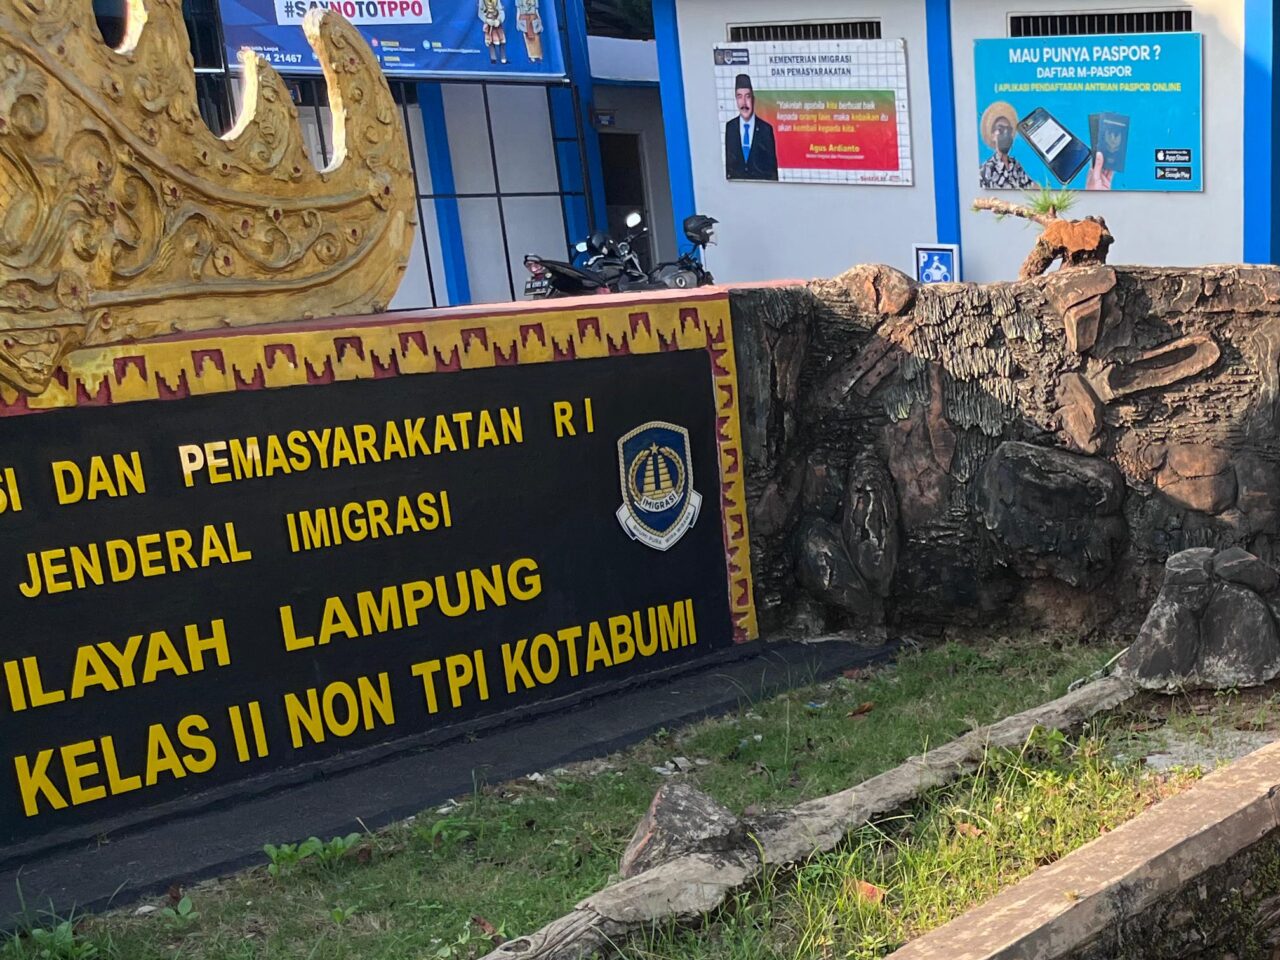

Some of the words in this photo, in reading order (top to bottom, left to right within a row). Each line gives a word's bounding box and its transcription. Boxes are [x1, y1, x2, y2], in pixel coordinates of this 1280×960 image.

[273, 53, 302, 63] 21467
[769, 55, 817, 64] KEMENTERIAN
[818, 55, 852, 64] IMIGRASI
[1009, 48, 1040, 63] MAU
[1043, 46, 1090, 63] PUNYA
[1092, 45, 1151, 62] PASPOR
[771, 68, 786, 76] DAN
[787, 67, 852, 76] PEMASYARAKATAN
[1036, 66, 1075, 78] DAFTAR
[1077, 66, 1132, 78] M-PASPOR
[1085, 82, 1118, 91] ANTRIAN
[1119, 82, 1151, 92] PASPOR
[1152, 82, 1182, 92] ONLINE
[809, 144, 827, 153] Agus
[828, 144, 860, 153] Ardianto
[919, 253, 929, 267] P
[51, 450, 147, 506] DAN
[178, 406, 524, 488] PEMASYARAKATAN
[642, 493, 677, 510] IMIGRASI
[18, 521, 252, 598] JENDERAL
[286, 490, 452, 553] IMIGRASI
[3, 618, 231, 712] ILAYAH
[279, 557, 543, 652] LAMPUNG
[14, 714, 217, 818] KELAS
[228, 700, 269, 763] II
[283, 671, 396, 750] NON
[411, 649, 490, 715] TPI
[501, 597, 699, 694] KOTABUMI
